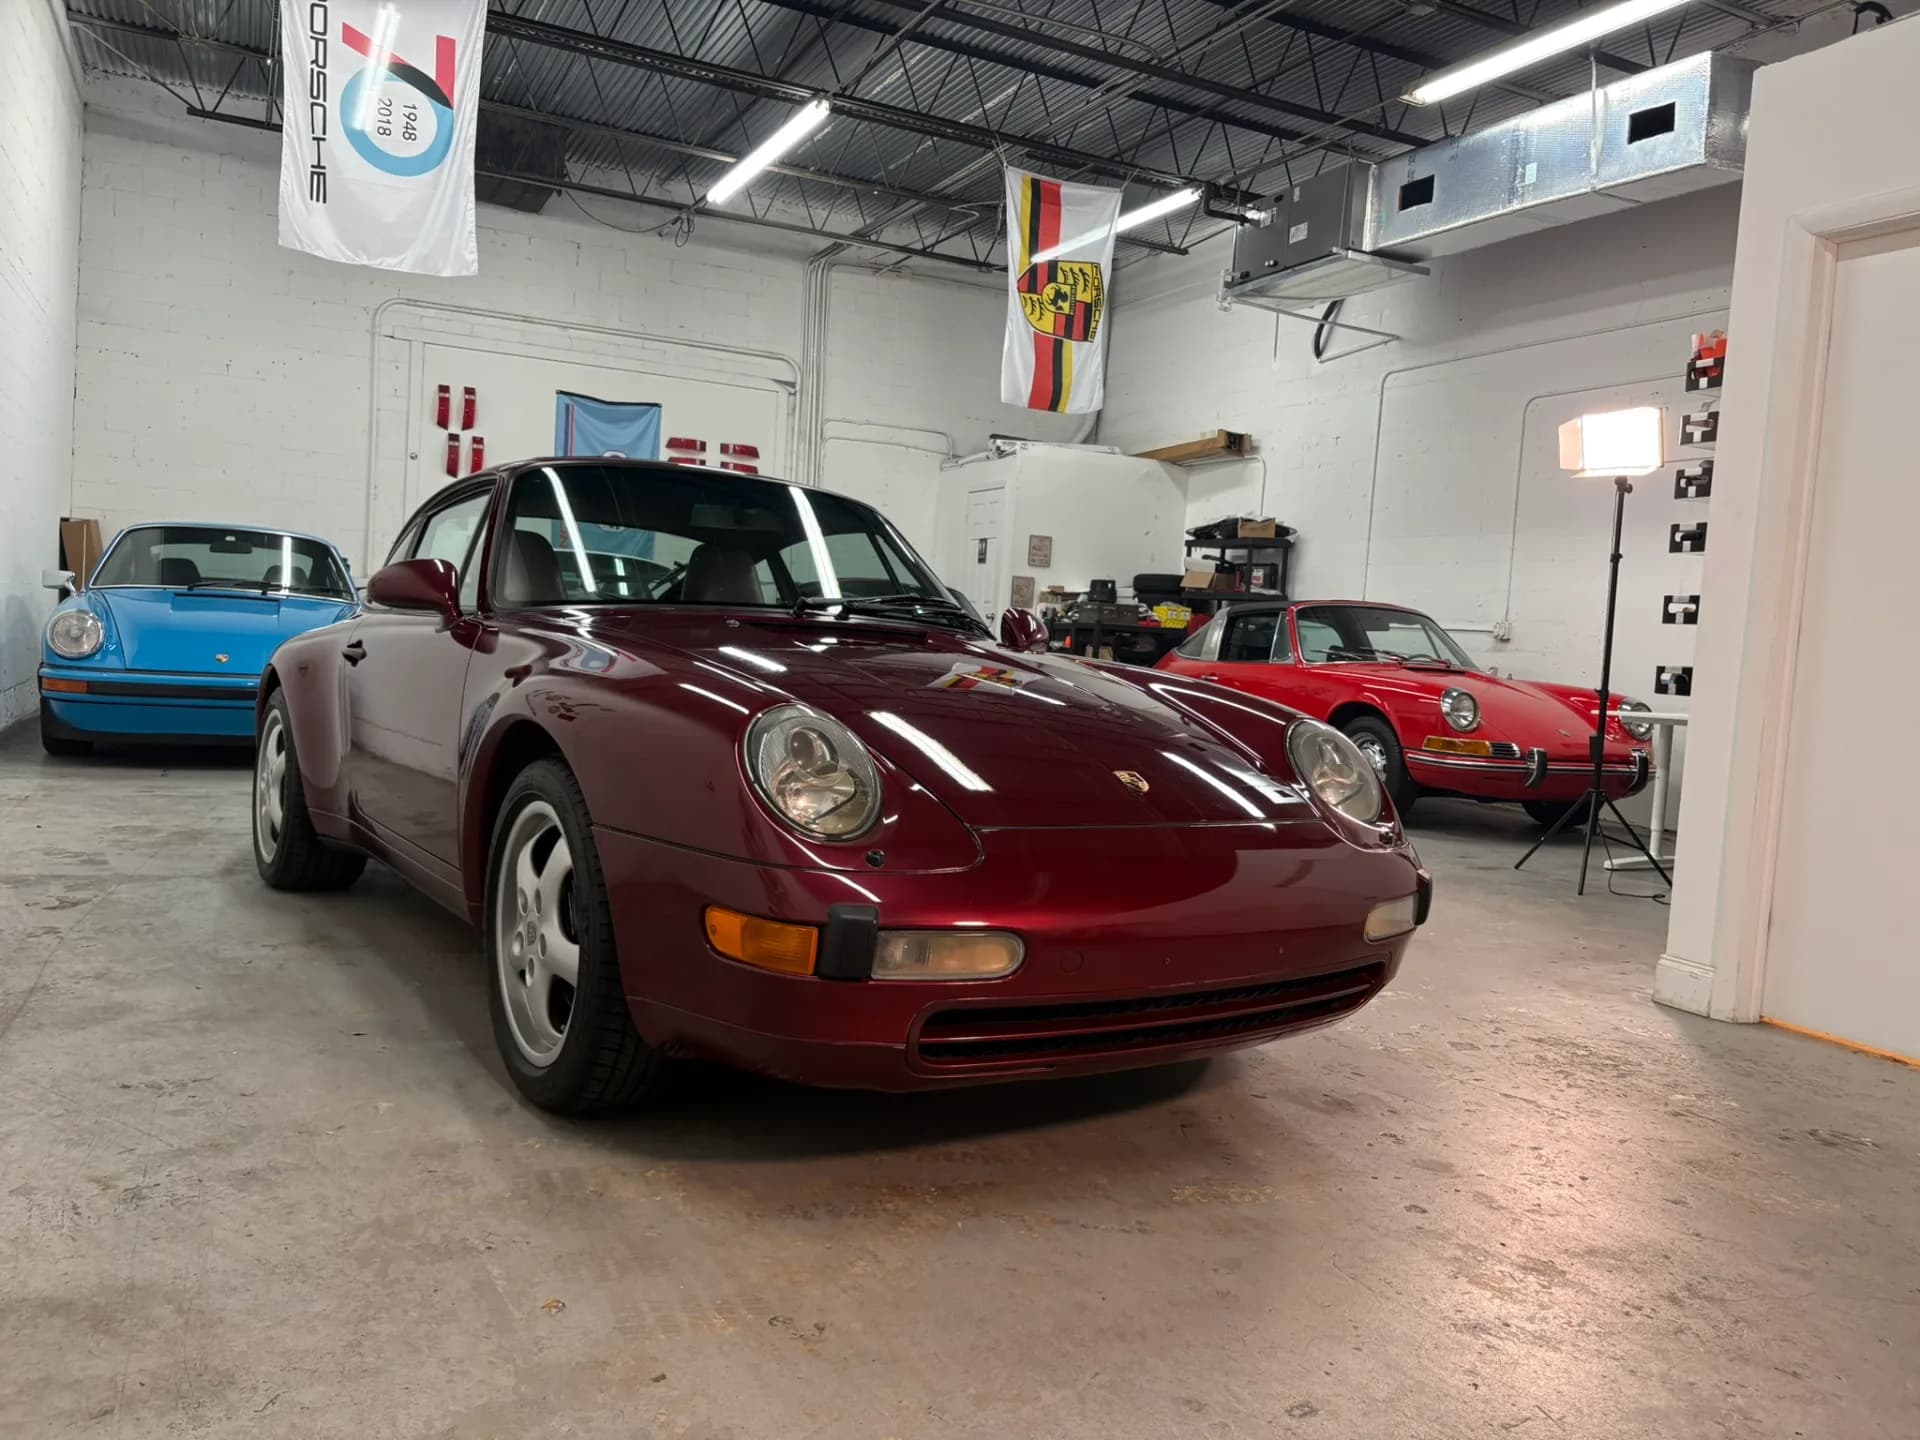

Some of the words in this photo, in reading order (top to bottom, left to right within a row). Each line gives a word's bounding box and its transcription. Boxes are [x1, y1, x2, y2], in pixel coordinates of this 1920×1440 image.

[309, 0, 328, 204] ORSCHE
[376, 97, 392, 137] 2018
[402, 104, 418, 141] 1948
[1090, 265, 1102, 340] PORSCHE
